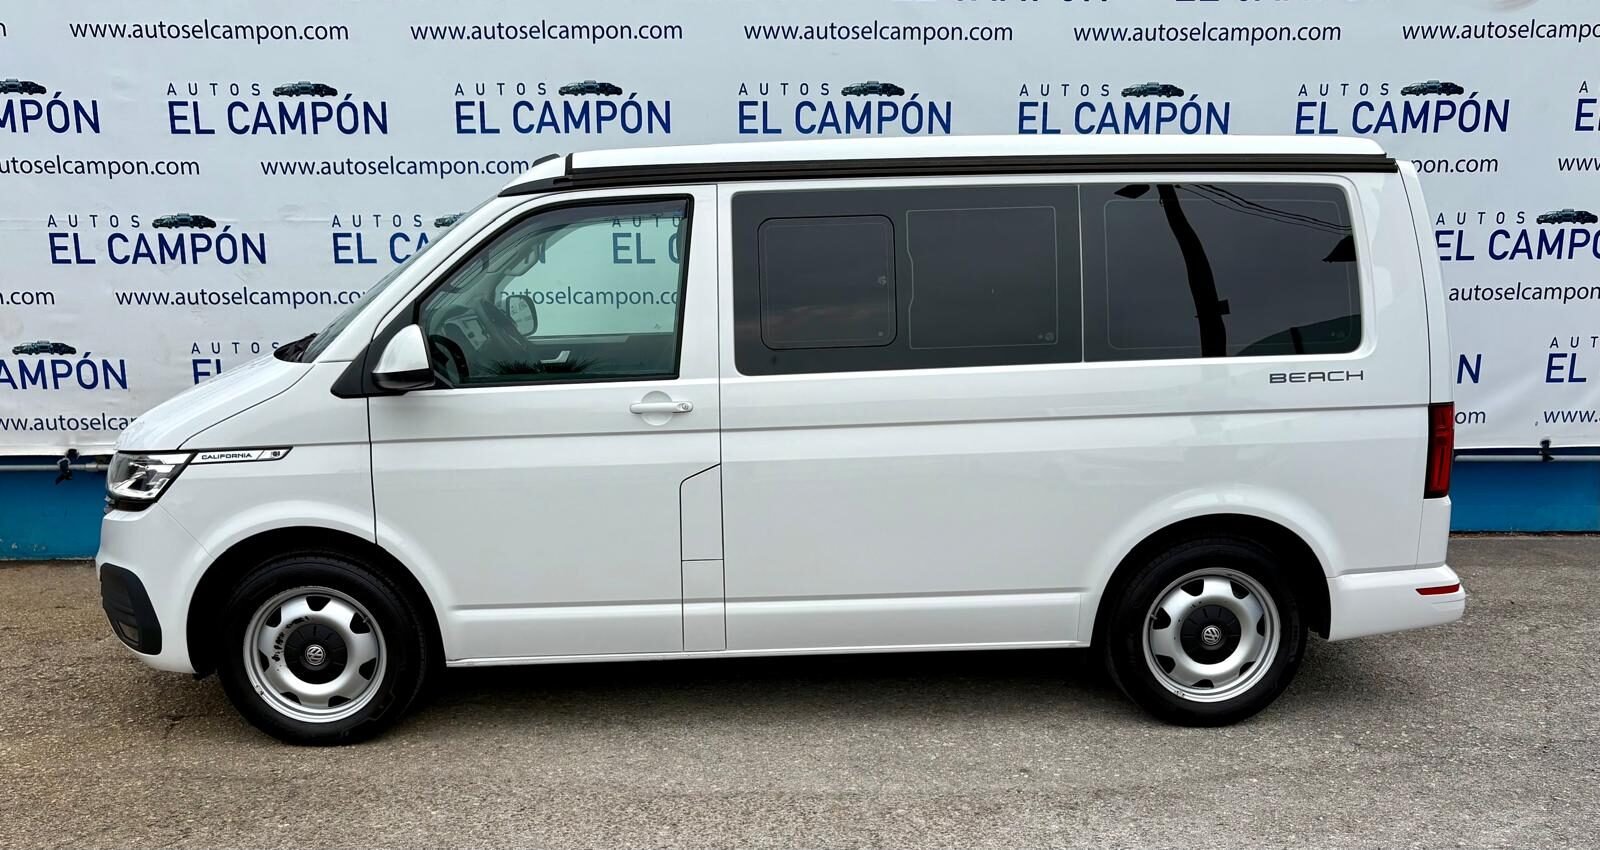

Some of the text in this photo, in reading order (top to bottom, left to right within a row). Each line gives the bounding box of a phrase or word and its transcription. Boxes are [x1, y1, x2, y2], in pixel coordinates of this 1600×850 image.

[70, 19, 348, 44] www.autoselcampon.com
[411, 20, 682, 44] www.autoselcampon.com
[744, 20, 1012, 45] www.autoselcampon.com
[1074, 22, 1340, 46] www.autoselcampon.com
[167, 83, 260, 96] AUTOS
[455, 83, 547, 95] AUTOS
[739, 83, 829, 95] AUTOS
[1020, 84, 1110, 96] AUTOS
[1298, 83, 1389, 96] AUTOS
[168, 94, 388, 135] EL CAMPÓN
[455, 93, 671, 134] EL CAMPÓN
[739, 94, 951, 134] EL CAMPÓN
[1018, 94, 1230, 134] EL CAMPÓN
[1296, 92, 1510, 134] EL CAMPÓN
[261, 156, 529, 179] www.autoselcampon.com
[48, 215, 140, 228] AUTOS
[332, 215, 422, 228] AUTOS
[1436, 212, 1525, 225] AUTOS
[49, 226, 267, 264] EL CAMPÓN
[332, 233, 377, 264] EL
[612, 232, 655, 264] EL
[1435, 229, 1474, 261] EL
[1269, 370, 1364, 384] BEACH
[1545, 353, 1586, 383] EL
